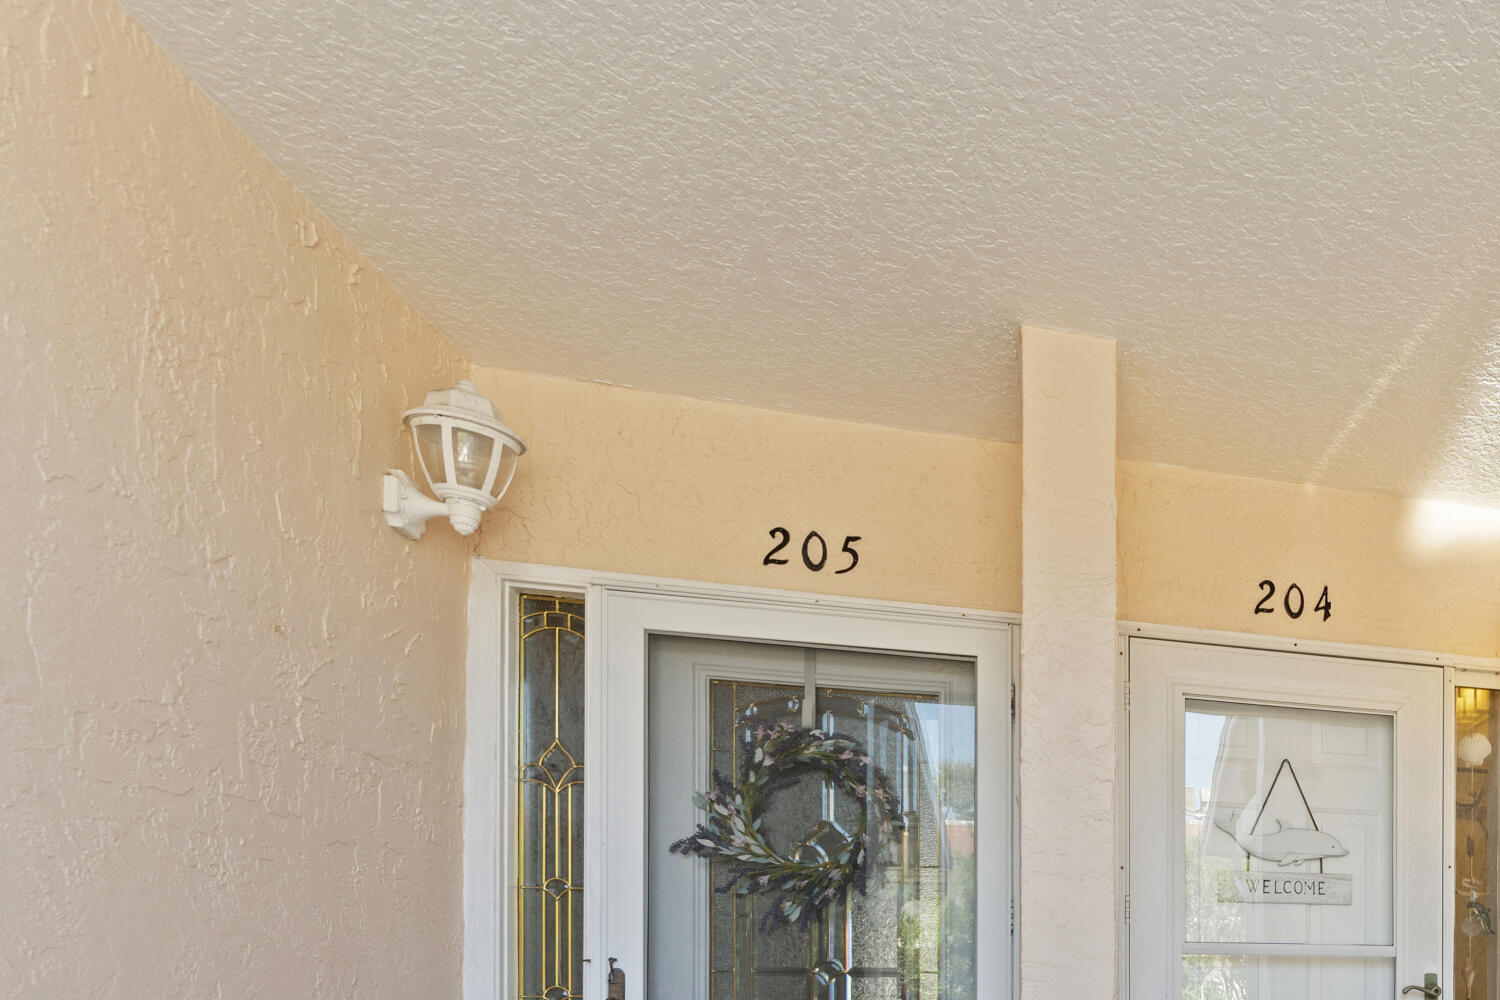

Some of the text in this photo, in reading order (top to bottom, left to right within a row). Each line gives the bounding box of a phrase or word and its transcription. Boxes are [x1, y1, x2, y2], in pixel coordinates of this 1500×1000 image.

[763, 526, 862, 574] 205
[1254, 579, 1332, 621] 204
[1246, 878, 1326, 896] WELCOME
